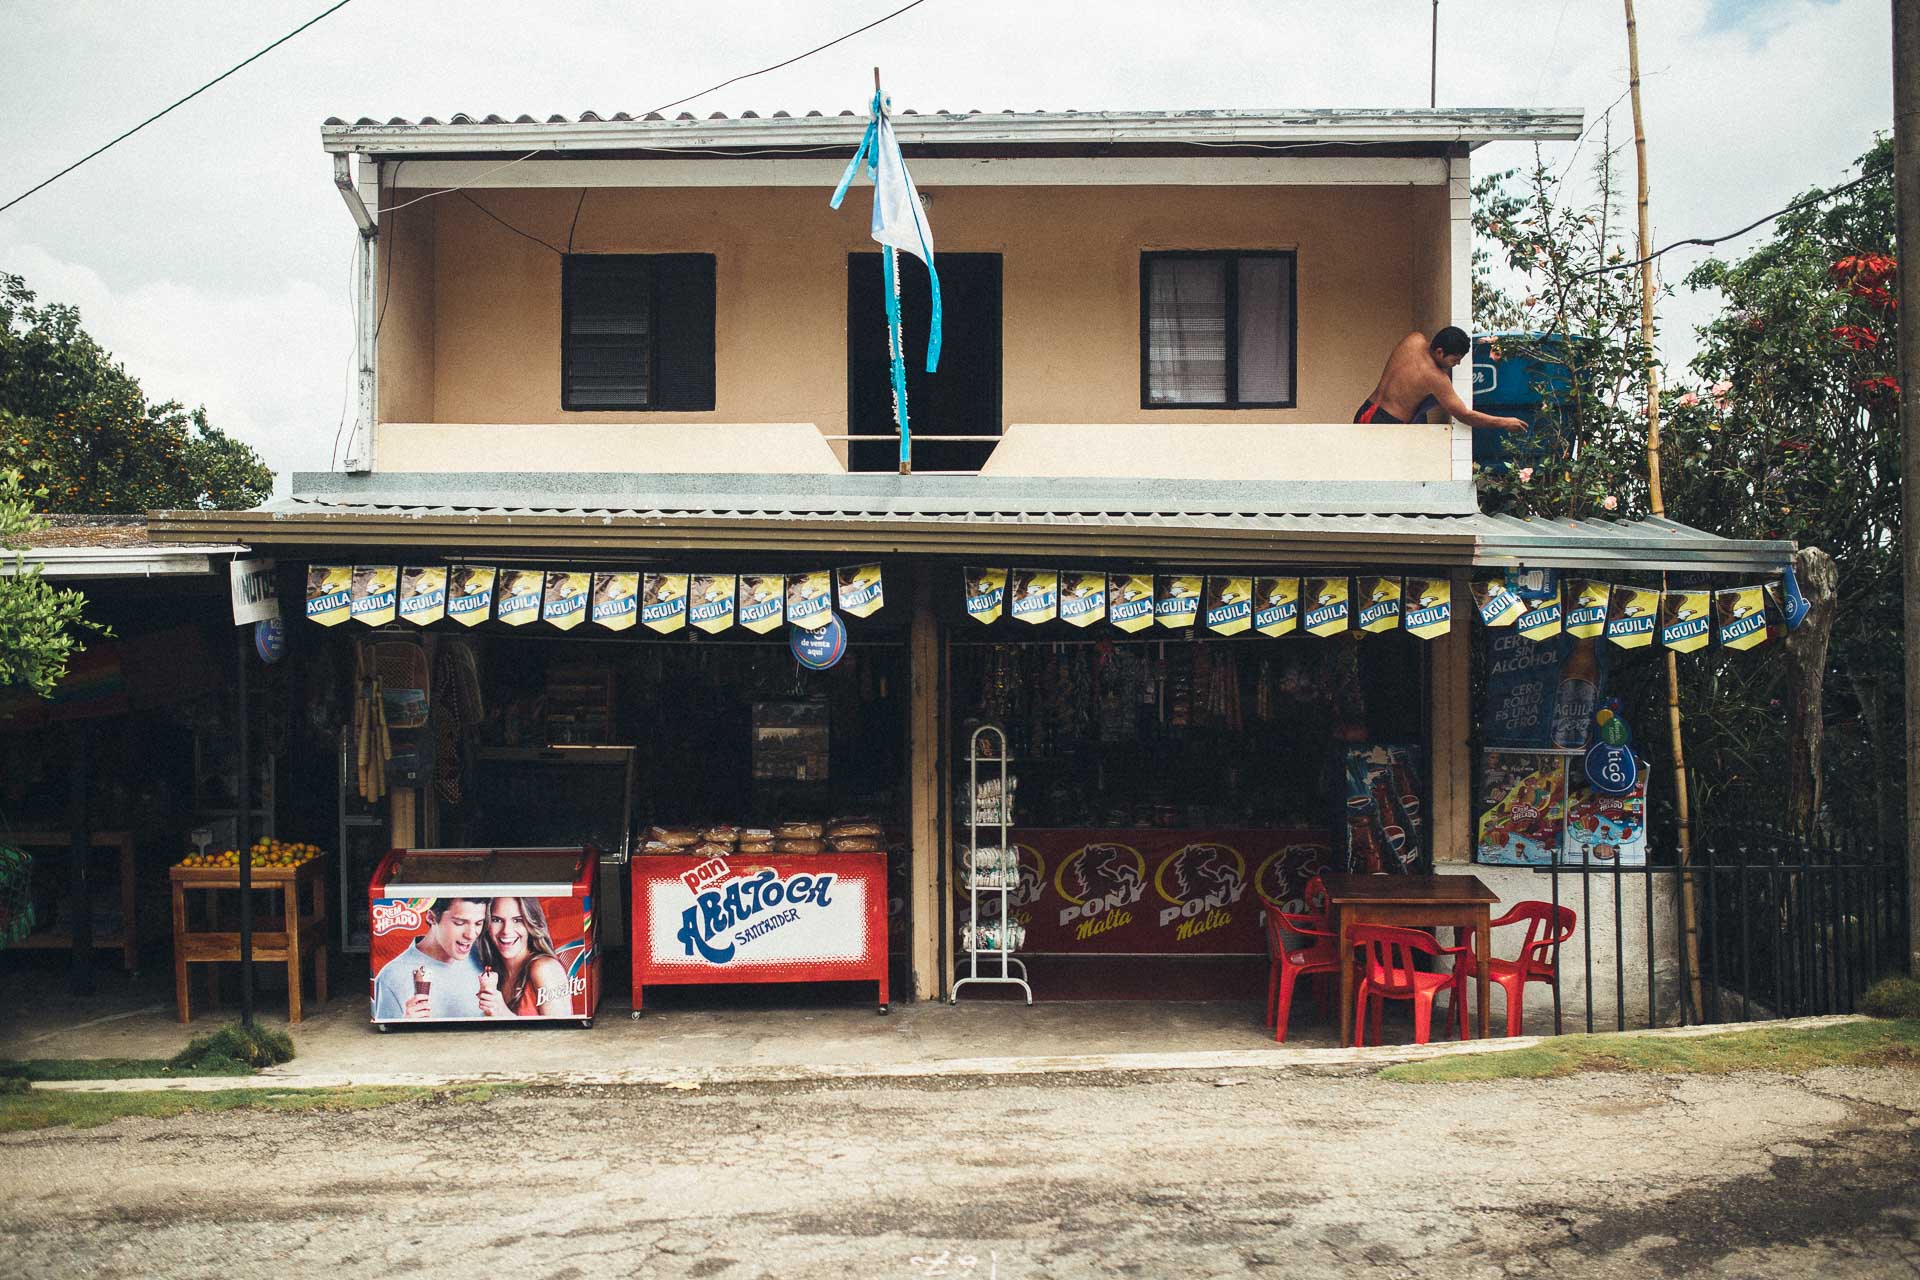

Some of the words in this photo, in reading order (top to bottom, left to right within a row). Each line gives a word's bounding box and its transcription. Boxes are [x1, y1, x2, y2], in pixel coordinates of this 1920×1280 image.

[307, 591, 350, 613] AGUILA
[351, 592, 395, 613] AGUILA
[400, 592, 445, 613] AGUILA
[448, 592, 491, 612] AGUILA
[498, 594, 540, 615] AGUILA
[545, 595, 587, 616] AGUILA
[594, 597, 636, 618] AGUILA
[643, 599, 686, 620] AGUILA
[691, 600, 734, 621] AGUILA
[741, 599, 784, 621] AGUILA
[787, 596, 831, 619] AGUILA
[968, 591, 1002, 611] AGUILA
[1013, 593, 1057, 614] AGUILA
[1061, 594, 1105, 615] AGUILA
[1111, 599, 1153, 620] AGUILA
[1155, 598, 1198, 614] AGUILA
[1207, 603, 1250, 624] AGUILA
[1256, 605, 1297, 626] AGUILA
[1306, 607, 1348, 627] AGUILA
[1360, 603, 1399, 624] AGUILA
[1407, 607, 1450, 626] AGUILA
[1517, 605, 1561, 629] AGUILA
[1566, 605, 1606, 626] AGUILA
[1609, 616, 1654, 634] AGUILA
[1663, 618, 1709, 641] AGUILA
[1721, 615, 1766, 641] AGUILA
[801, 638, 809, 646] de
[810, 640, 831, 648] venta
[1494, 635, 1538, 650] CERV
[1516, 644, 1535, 658] SIN
[1491, 650, 1560, 675] ALCOHOL
[1511, 682, 1543, 697] CERO
[1495, 709, 1509, 721] ES
[1511, 704, 1539, 718] UNA
[1554, 702, 1594, 716] AGUILA
[1607, 750, 1623, 783] tigo
[683, 858, 726, 894] pan
[1059, 881, 1148, 927] PONY
[1159, 881, 1248, 928] PONY
[375, 912, 418, 932] HELADO
[677, 870, 833, 964] ARATOCA
[734, 908, 801, 946] SANTANDER
[1076, 910, 1132, 941] Malta
[1176, 910, 1232, 941] Malta
